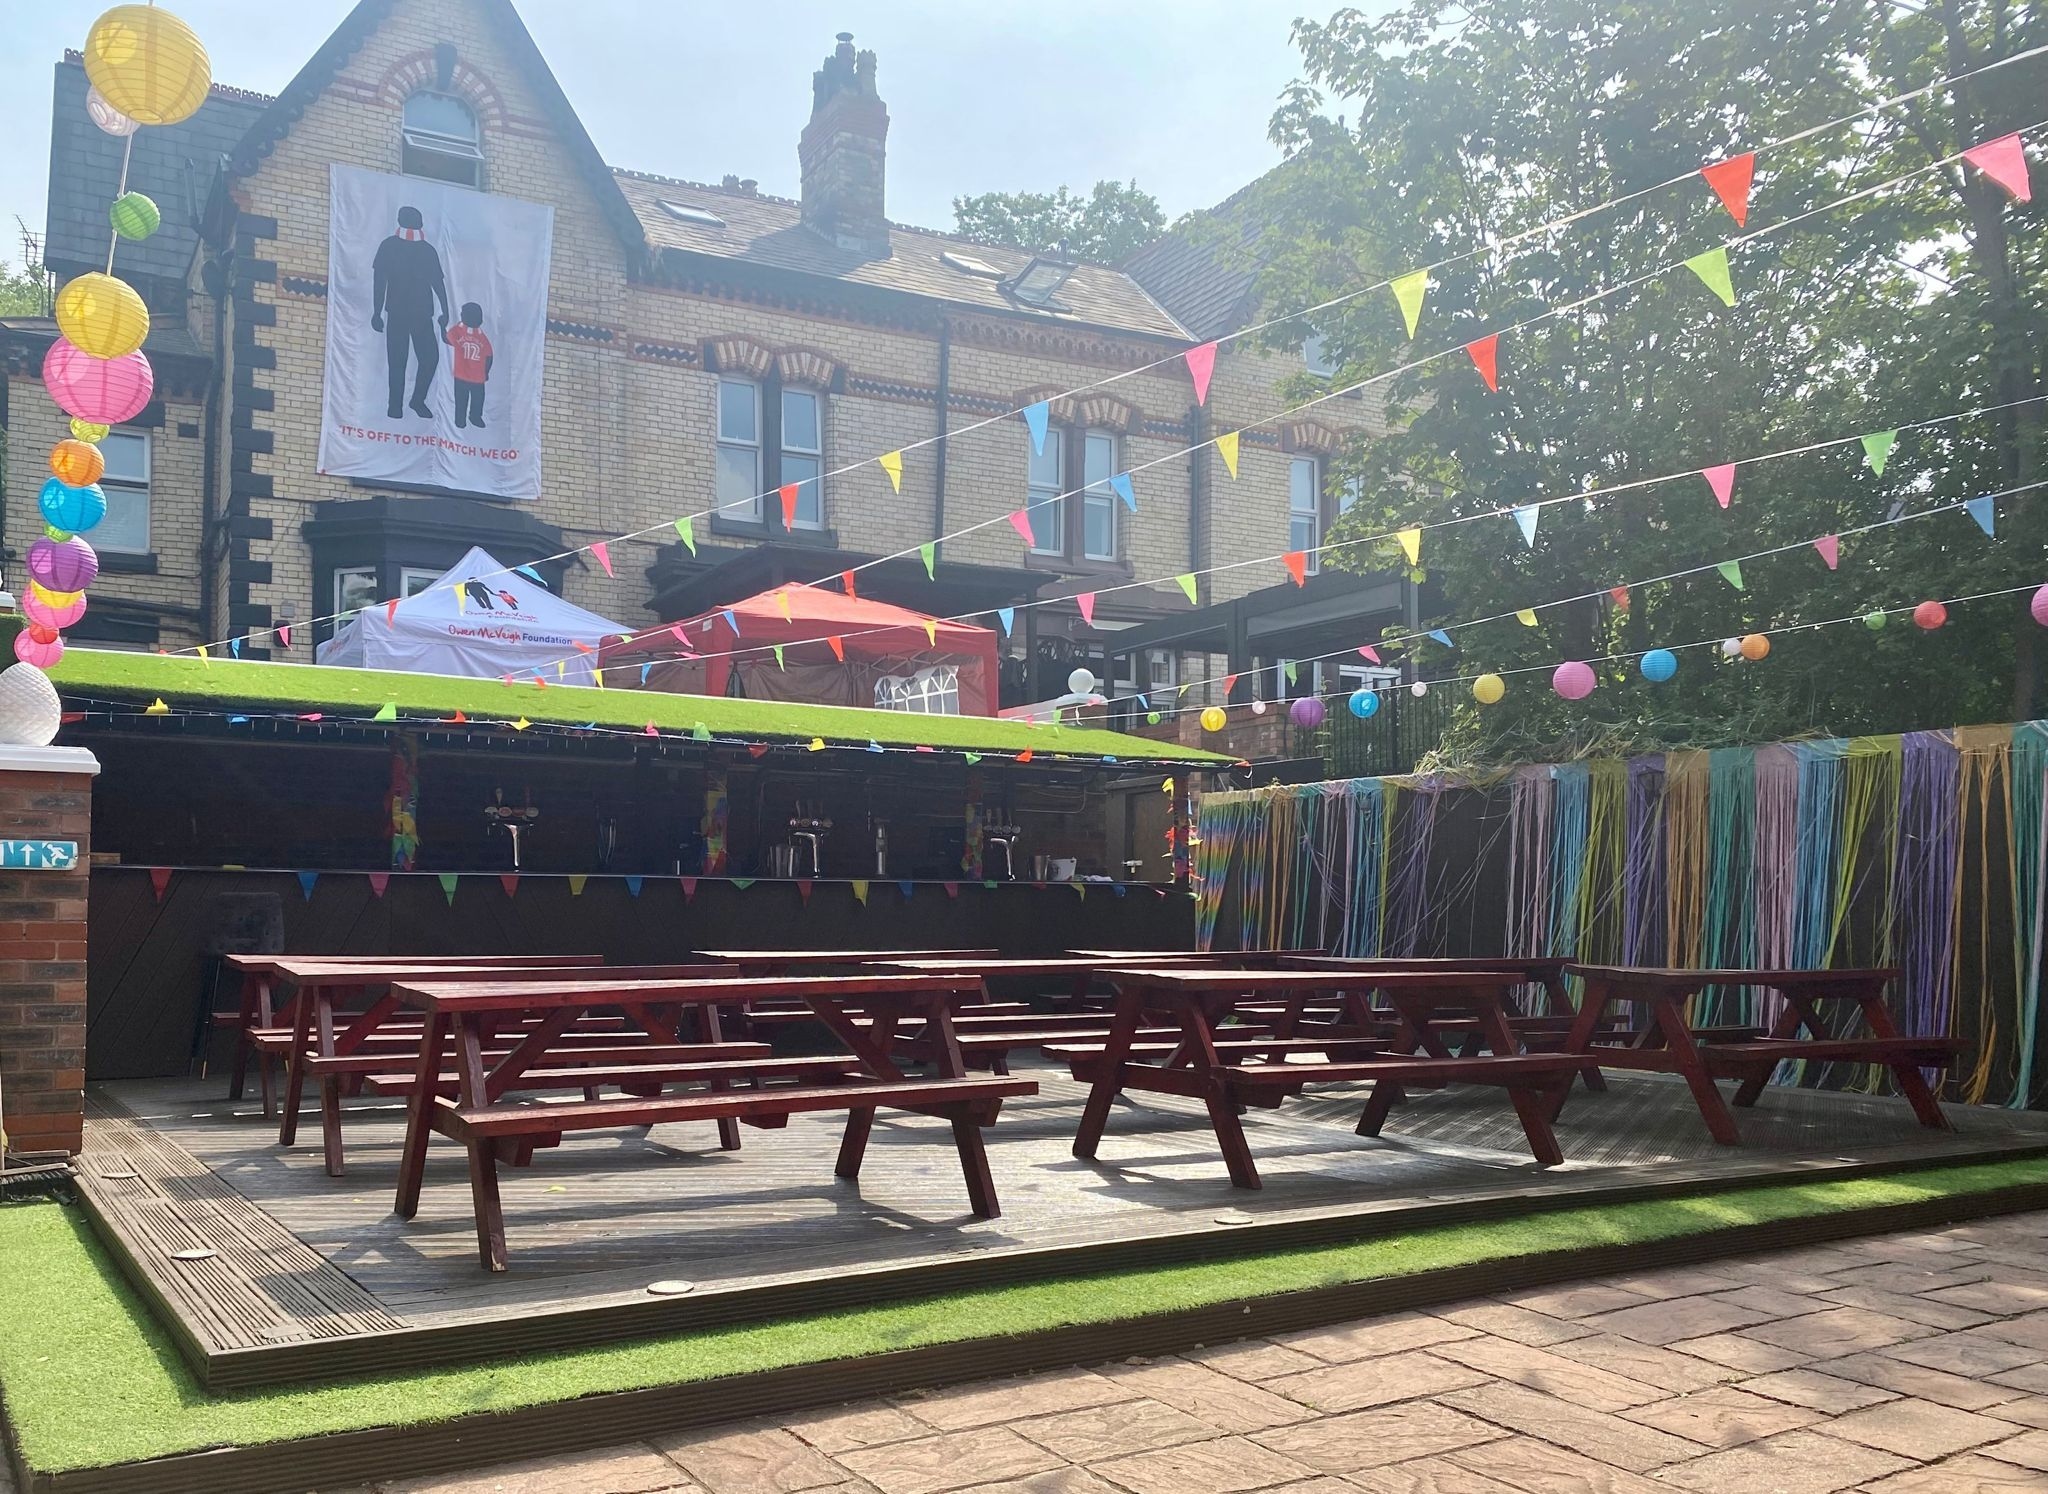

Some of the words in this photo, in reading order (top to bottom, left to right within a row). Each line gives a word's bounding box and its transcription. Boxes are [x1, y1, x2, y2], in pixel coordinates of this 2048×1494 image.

[462, 342, 480, 361] 12
[367, 430, 391, 443] OFF
[394, 434, 412, 445] TO
[415, 436, 437, 447] THE
[439, 438, 476, 457] MATCH
[479, 448, 498, 460] WE
[448, 624, 475, 636] Owen
[478, 626, 521, 643] McVeigh
[522, 633, 573, 645] Foundation
